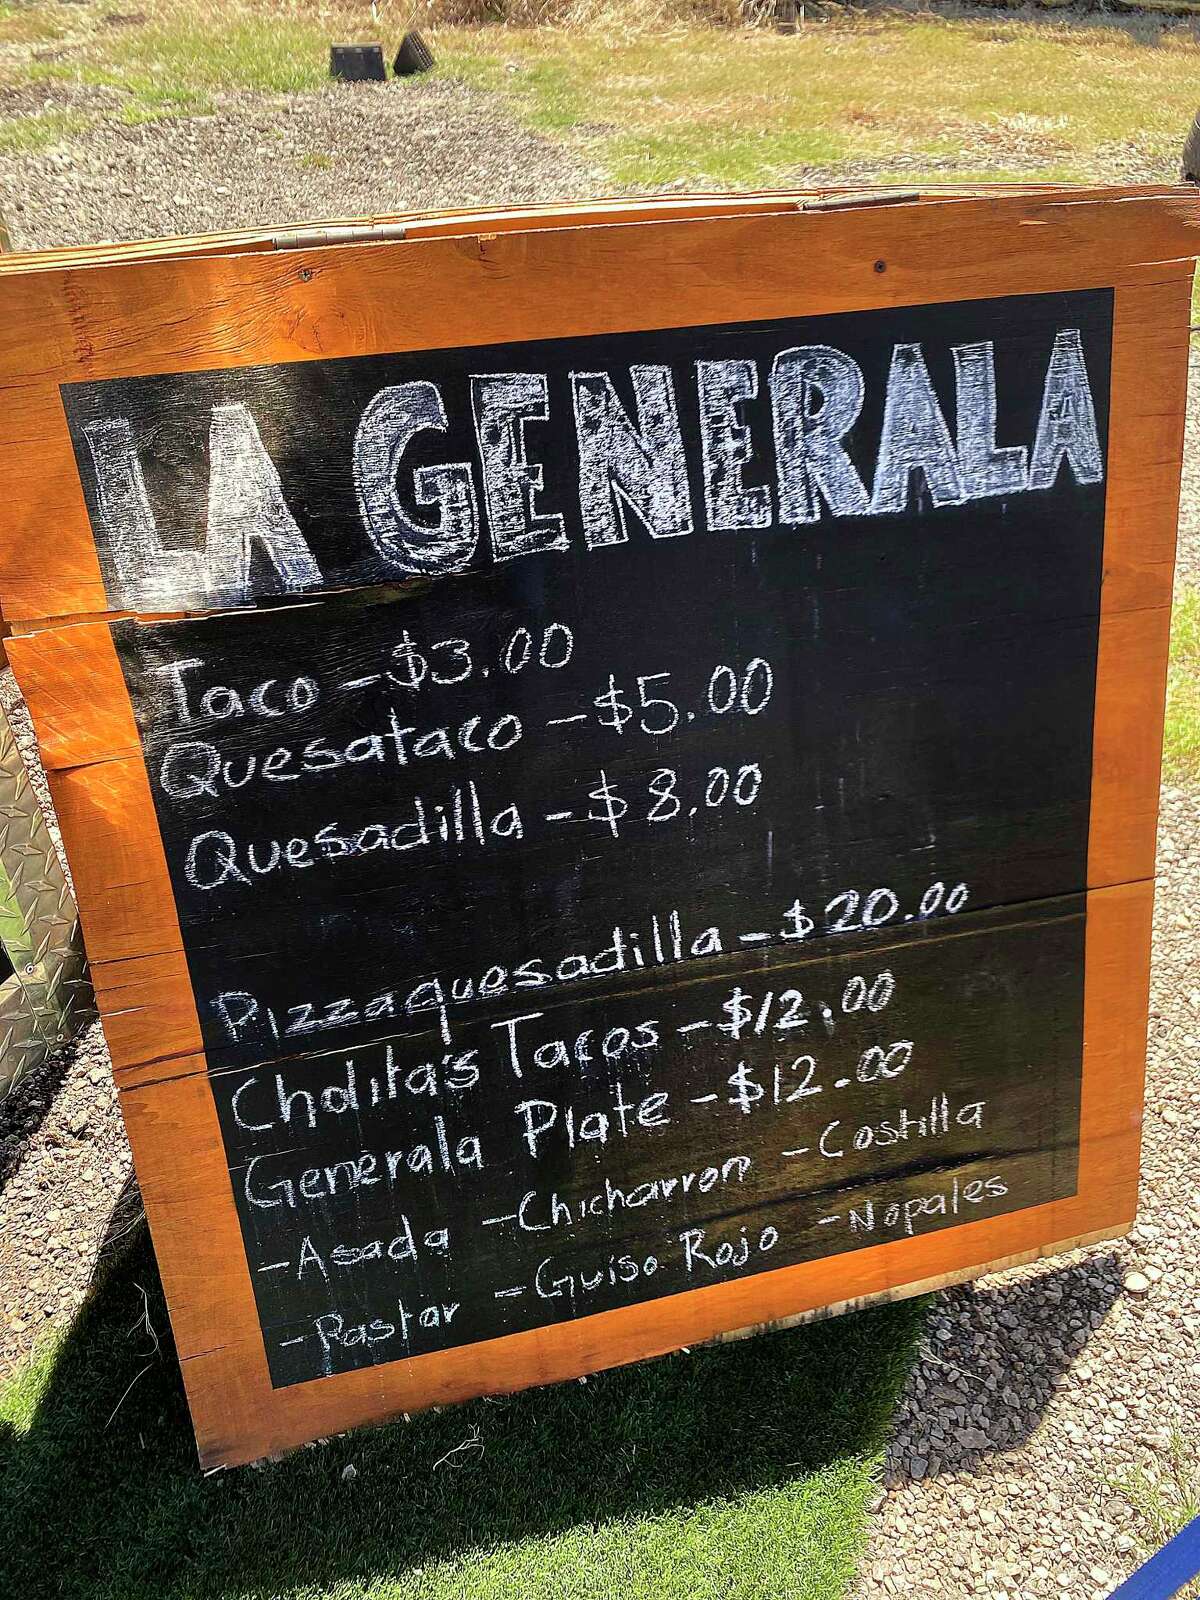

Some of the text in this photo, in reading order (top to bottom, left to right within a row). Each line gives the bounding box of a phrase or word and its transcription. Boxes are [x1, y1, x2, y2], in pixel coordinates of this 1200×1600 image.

[82, 327, 1105, 609] LA GENERALA
[155, 656, 320, 724] Taco
[159, 708, 523, 800] Quesataco
[183, 780, 524, 891] Quesadilla
[209, 909, 724, 1045] Pizzaquesadilla
[490, 1012, 661, 1078] Tacos
[244, 1115, 485, 1208] Generala
[514, 1082, 671, 1158] Plate
[679, 1225, 779, 1272] Rojo
